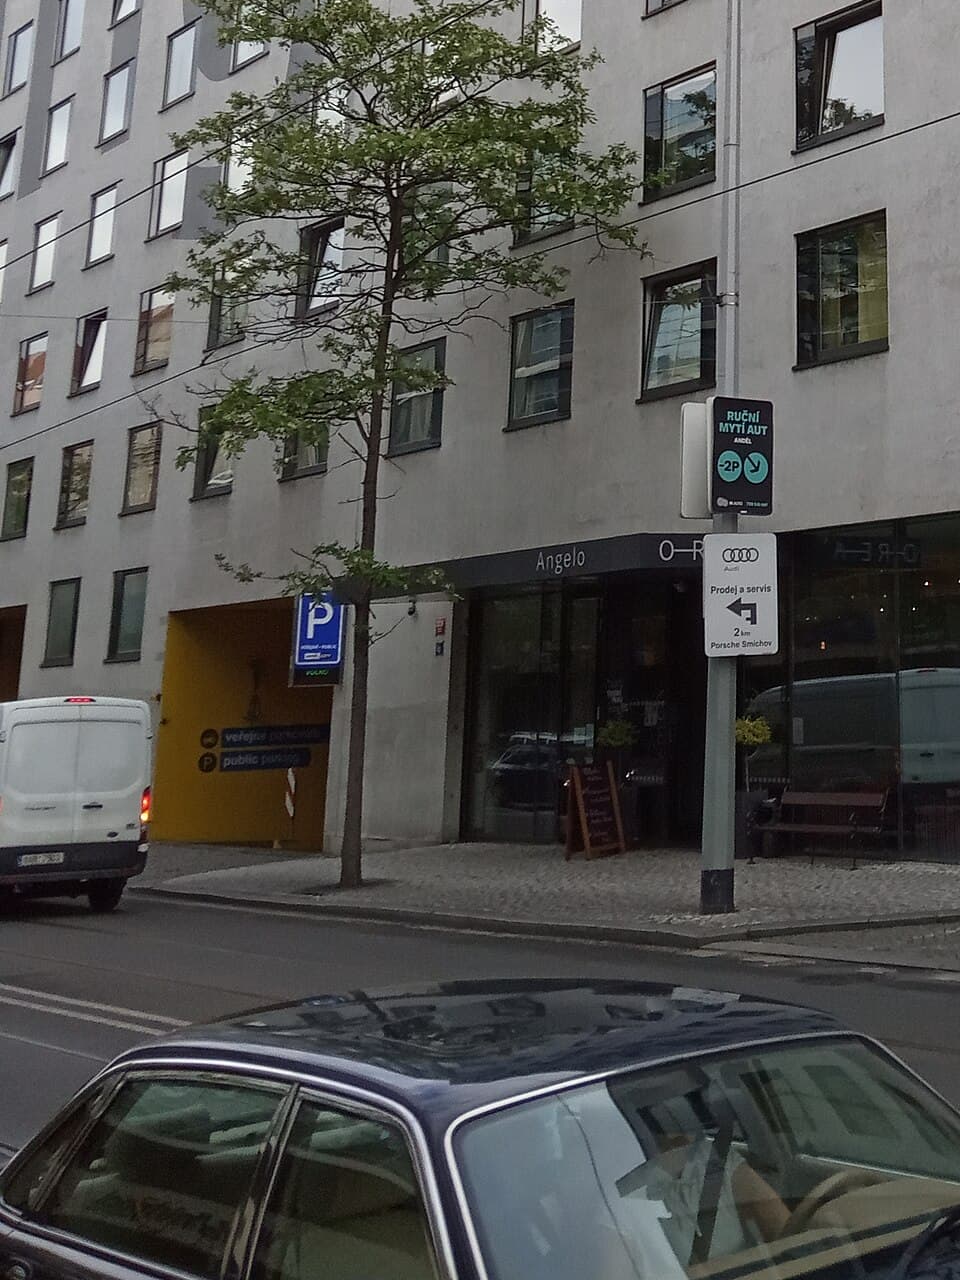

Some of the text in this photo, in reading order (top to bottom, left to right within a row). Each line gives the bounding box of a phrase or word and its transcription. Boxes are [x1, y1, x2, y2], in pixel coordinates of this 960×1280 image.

[727, 410, 760, 422] RUČNÍ
[719, 422, 768, 435] MYTÍ AUT
[536, 546, 586, 575] Angelo
[710, 585, 737, 595] Prodej
[746, 584, 771, 593] servis
[307, 601, 334, 639] P
[734, 628, 740, 636] 2
[710, 641, 740, 649] Porsche
